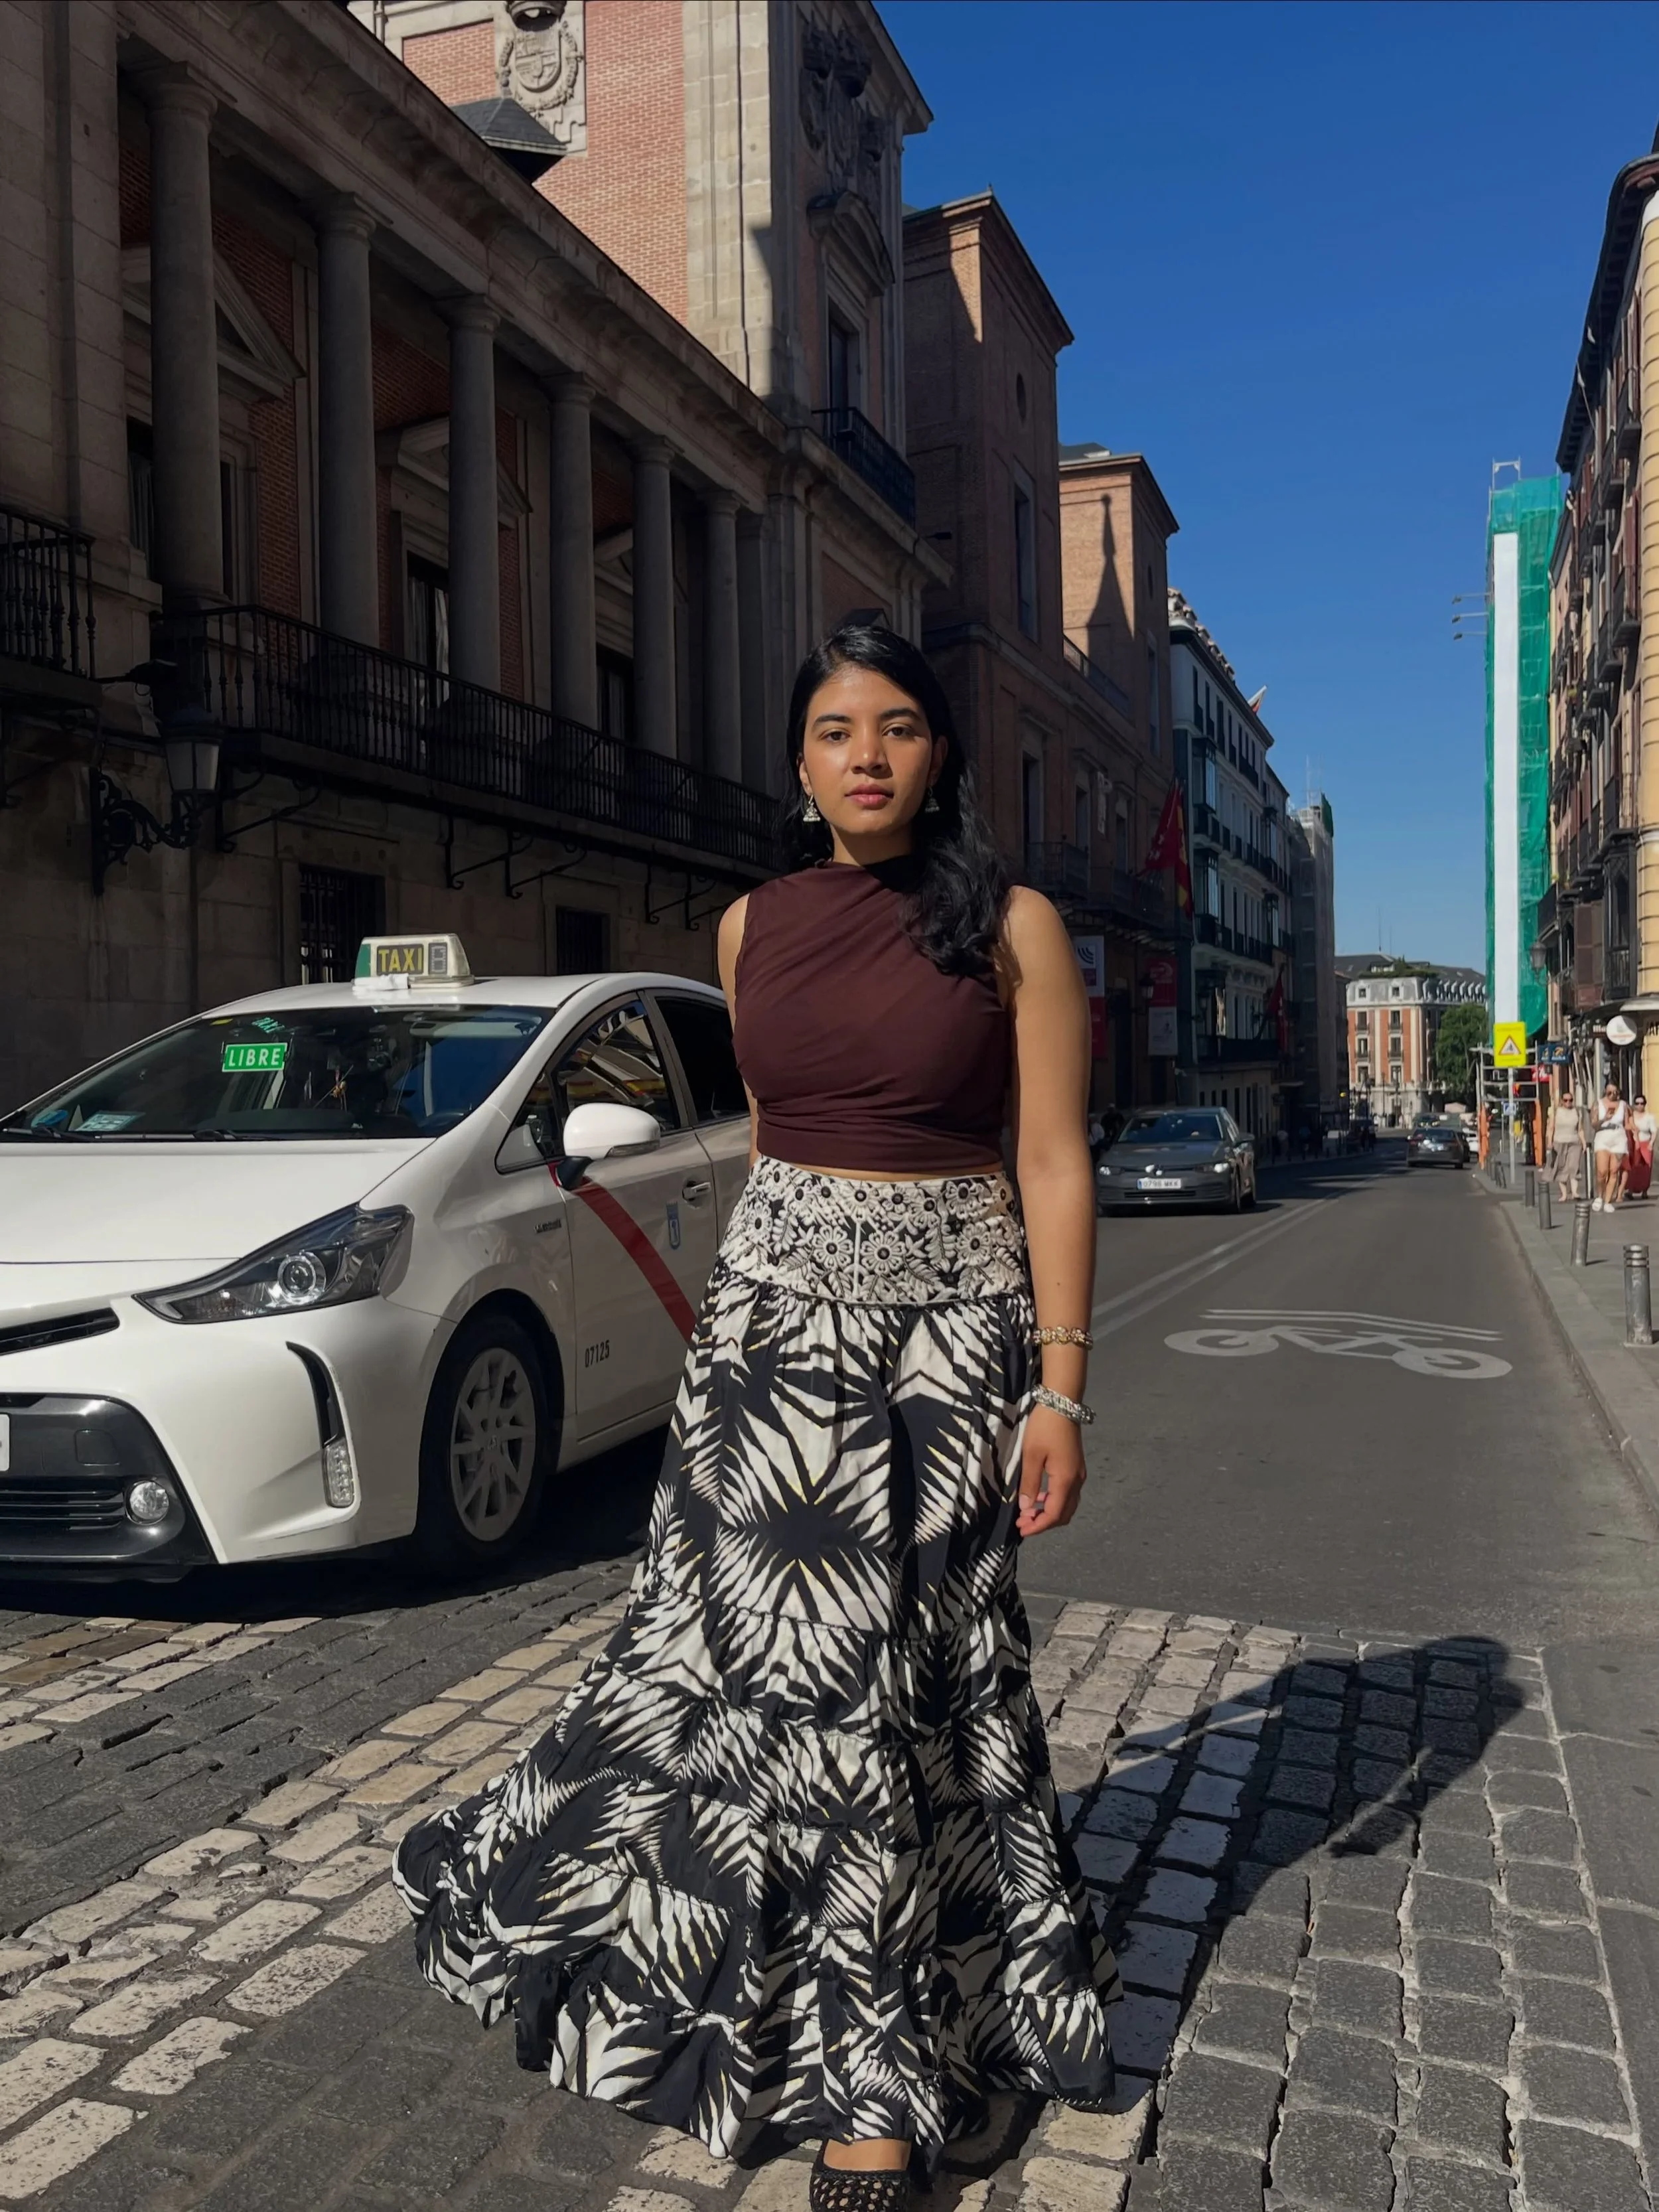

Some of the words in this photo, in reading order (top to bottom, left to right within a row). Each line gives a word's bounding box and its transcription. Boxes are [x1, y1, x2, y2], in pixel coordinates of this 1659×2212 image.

[378, 948, 422, 972] TAXI
[228, 1048, 281, 1067] LIBRE
[585, 1339, 610, 1368] 07125
